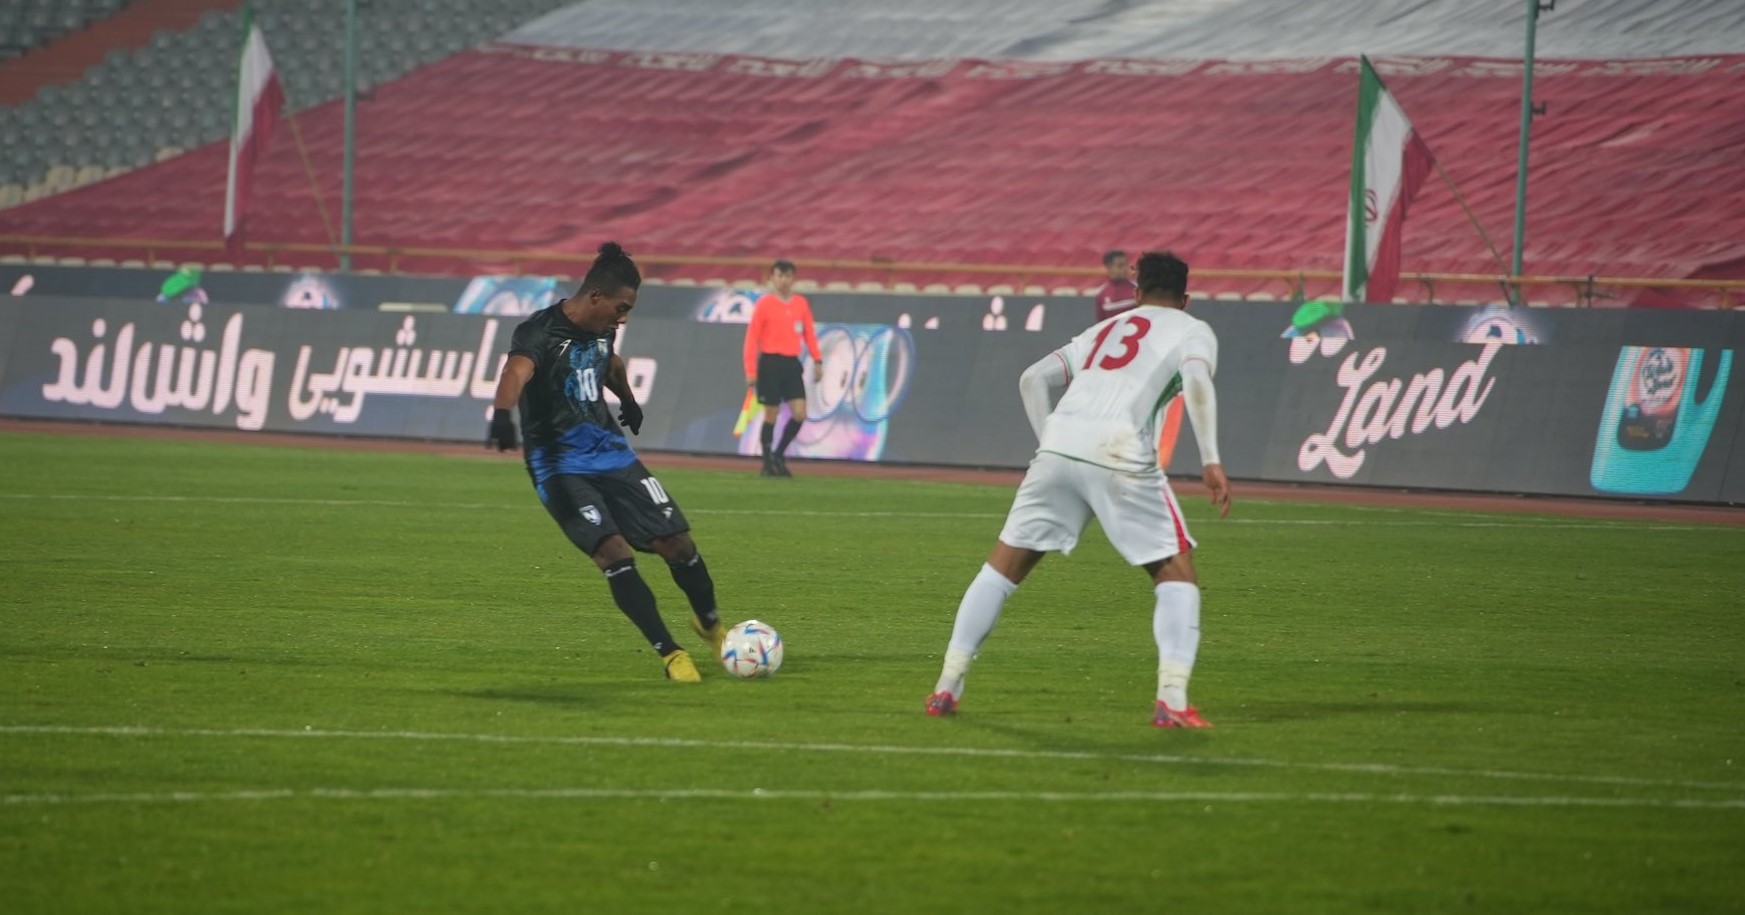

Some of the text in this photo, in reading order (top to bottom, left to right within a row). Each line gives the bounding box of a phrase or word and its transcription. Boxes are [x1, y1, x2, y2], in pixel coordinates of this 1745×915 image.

[1081, 315, 1151, 371] 13
[575, 367, 599, 402] 10
[1298, 343, 1503, 479] Land
[640, 476, 669, 505] 10
